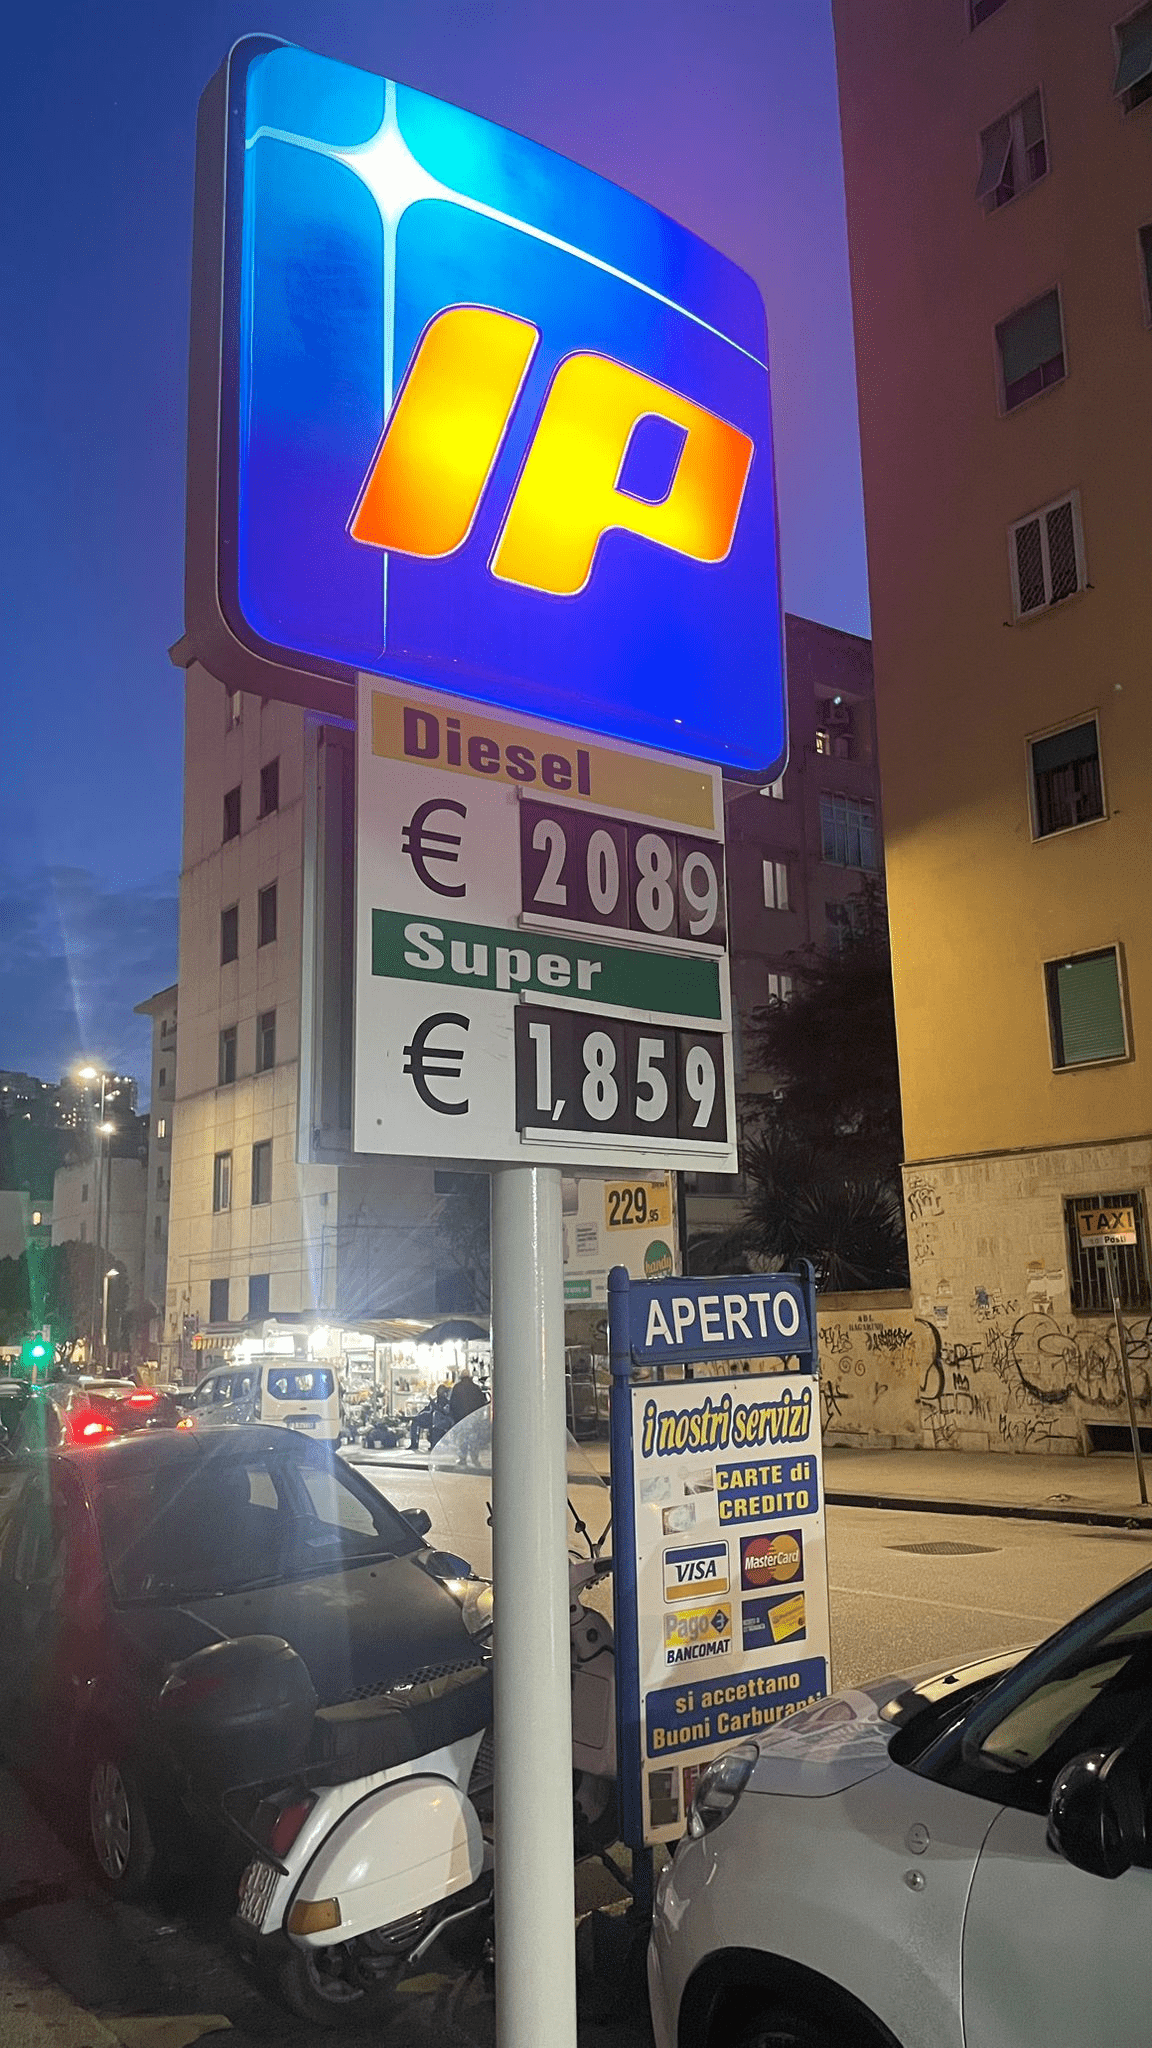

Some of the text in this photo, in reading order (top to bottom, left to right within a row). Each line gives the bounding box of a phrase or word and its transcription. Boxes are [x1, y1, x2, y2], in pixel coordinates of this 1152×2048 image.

[404, 706, 590, 796] Diesel
[401, 798, 718, 936] € 2089
[403, 922, 603, 990] Super
[402, 1012, 716, 1128] € 1,859
[1080, 1211, 1133, 1231] TAXI
[645, 1290, 800, 1346] APERTO
[643, 1390, 811, 1455] i nostri servizi
[716, 1462, 810, 1491] CARTE di
[719, 1490, 809, 1519] CREDITO
[675, 1559, 717, 1583] VISA
[744, 1550, 799, 1571] MasterCard
[665, 1615, 709, 1641] Pago
[667, 1639, 731, 1663] BANCOMAT
[675, 1673, 800, 1714] si accettano
[653, 1716, 711, 1750] Buoni
